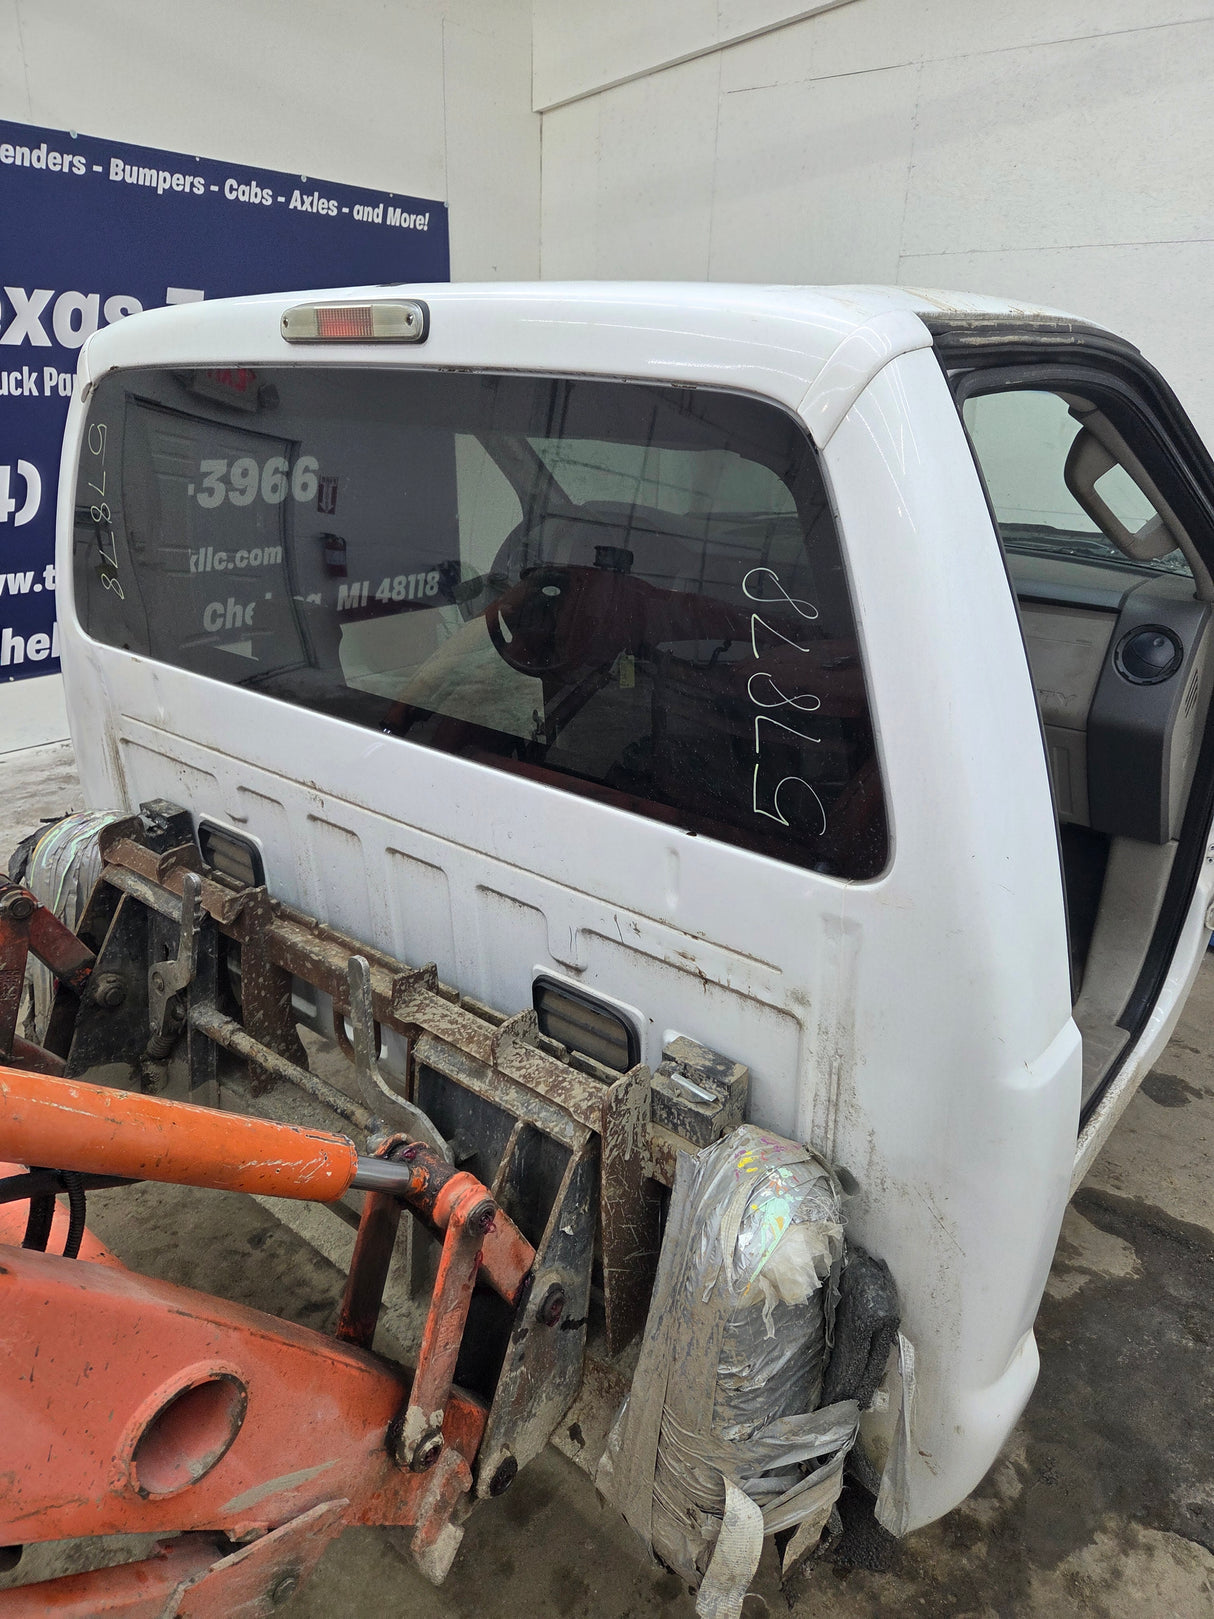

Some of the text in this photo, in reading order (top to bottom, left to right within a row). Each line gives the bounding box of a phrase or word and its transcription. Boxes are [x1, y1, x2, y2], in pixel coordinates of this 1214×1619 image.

[0, 143, 87, 175] enders
[109, 157, 205, 195] Bumpers
[224, 178, 273, 206] Cabs
[288, 190, 338, 216] Axles
[353, 203, 384, 224] and
[386, 206, 430, 232] More!
[88, 423, 125, 600] 57878
[337, 581, 370, 612] MI
[375, 570, 440, 604] 48118
[742, 567, 827, 836] 57878
